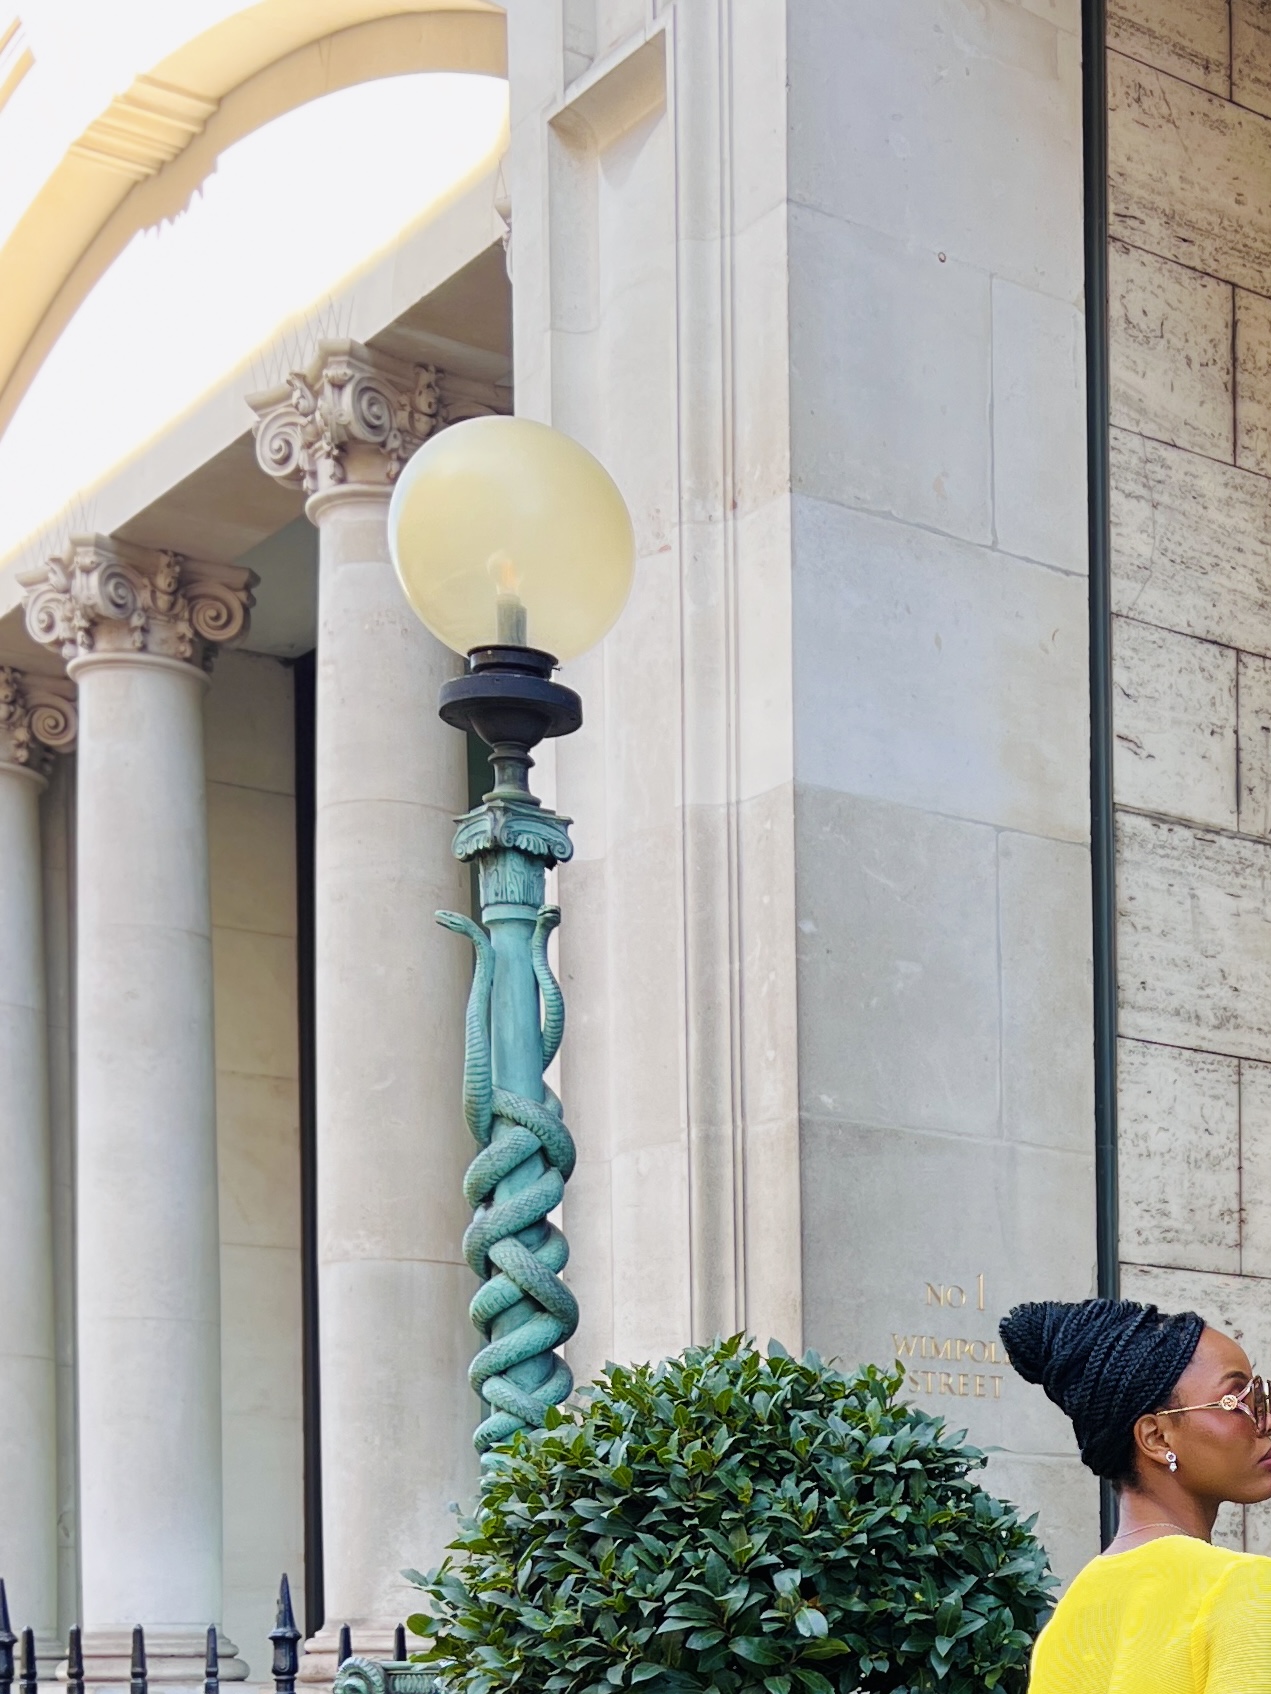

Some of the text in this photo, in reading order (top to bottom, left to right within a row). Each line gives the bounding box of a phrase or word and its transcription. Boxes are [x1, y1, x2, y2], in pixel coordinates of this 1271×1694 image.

[977, 1273, 985, 1311] 1
[891, 1333, 1012, 1365] WIMPOL
[909, 1370, 1003, 1398] STREET
